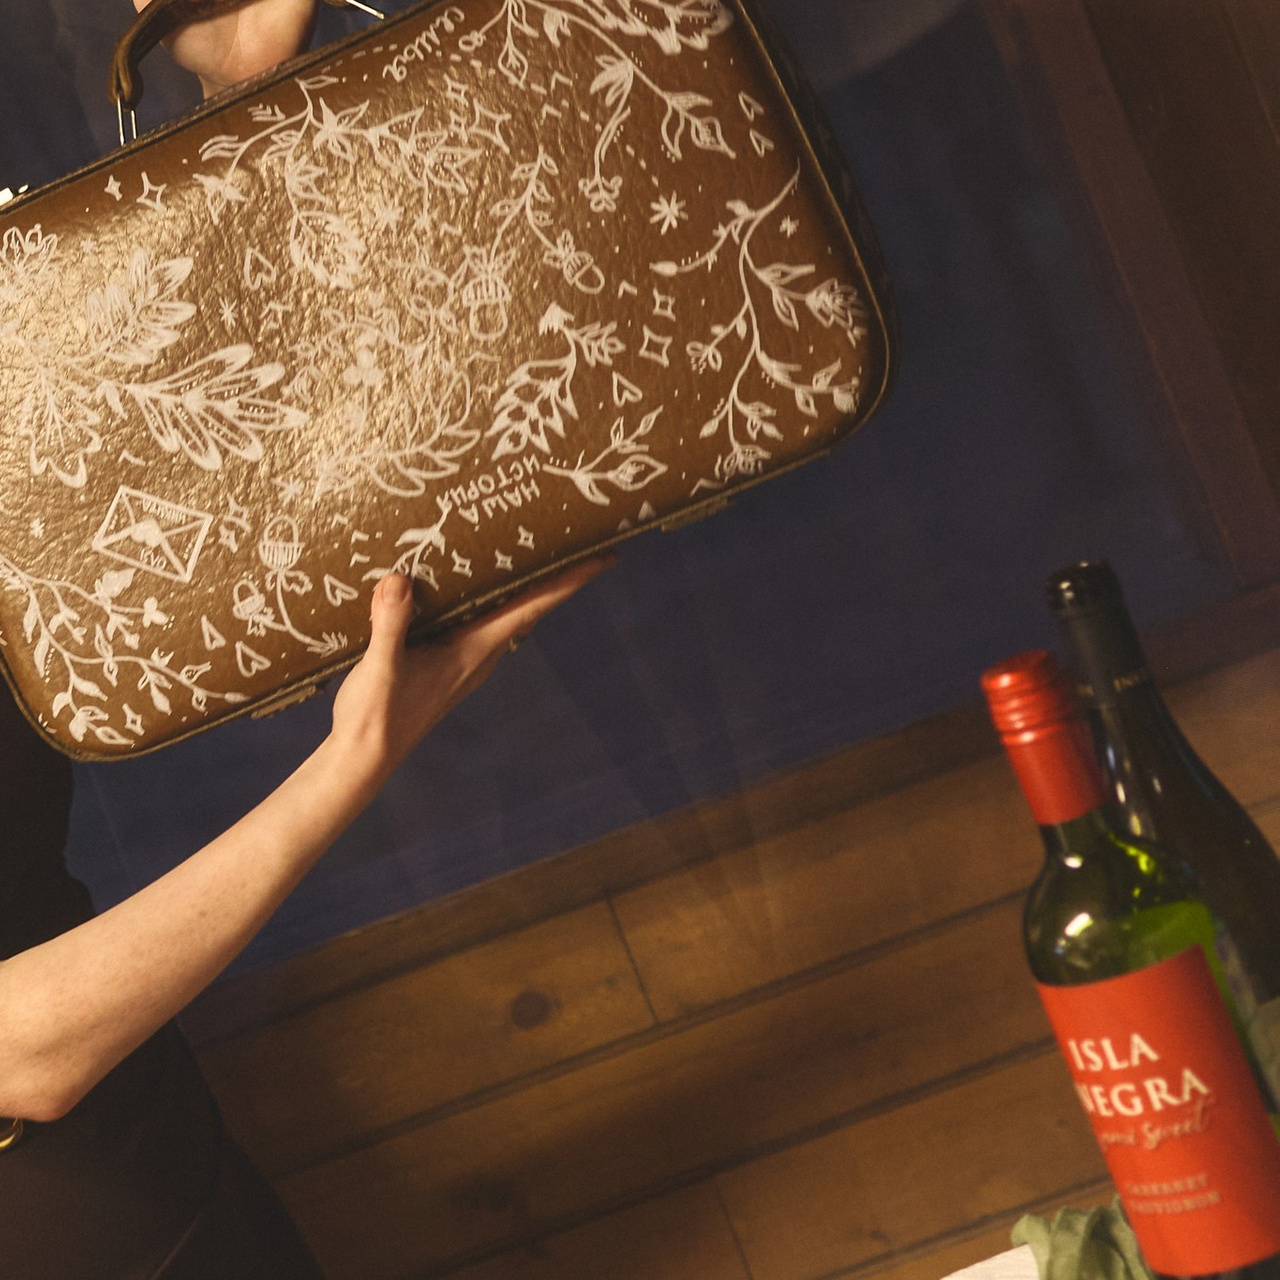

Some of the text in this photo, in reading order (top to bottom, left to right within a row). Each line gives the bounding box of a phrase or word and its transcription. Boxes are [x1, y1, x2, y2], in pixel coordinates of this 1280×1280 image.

[436, 453, 540, 513] ИСТОРИЯ
[458, 478, 540, 525] НАША
[1067, 1032, 1159, 1072] ISLA
